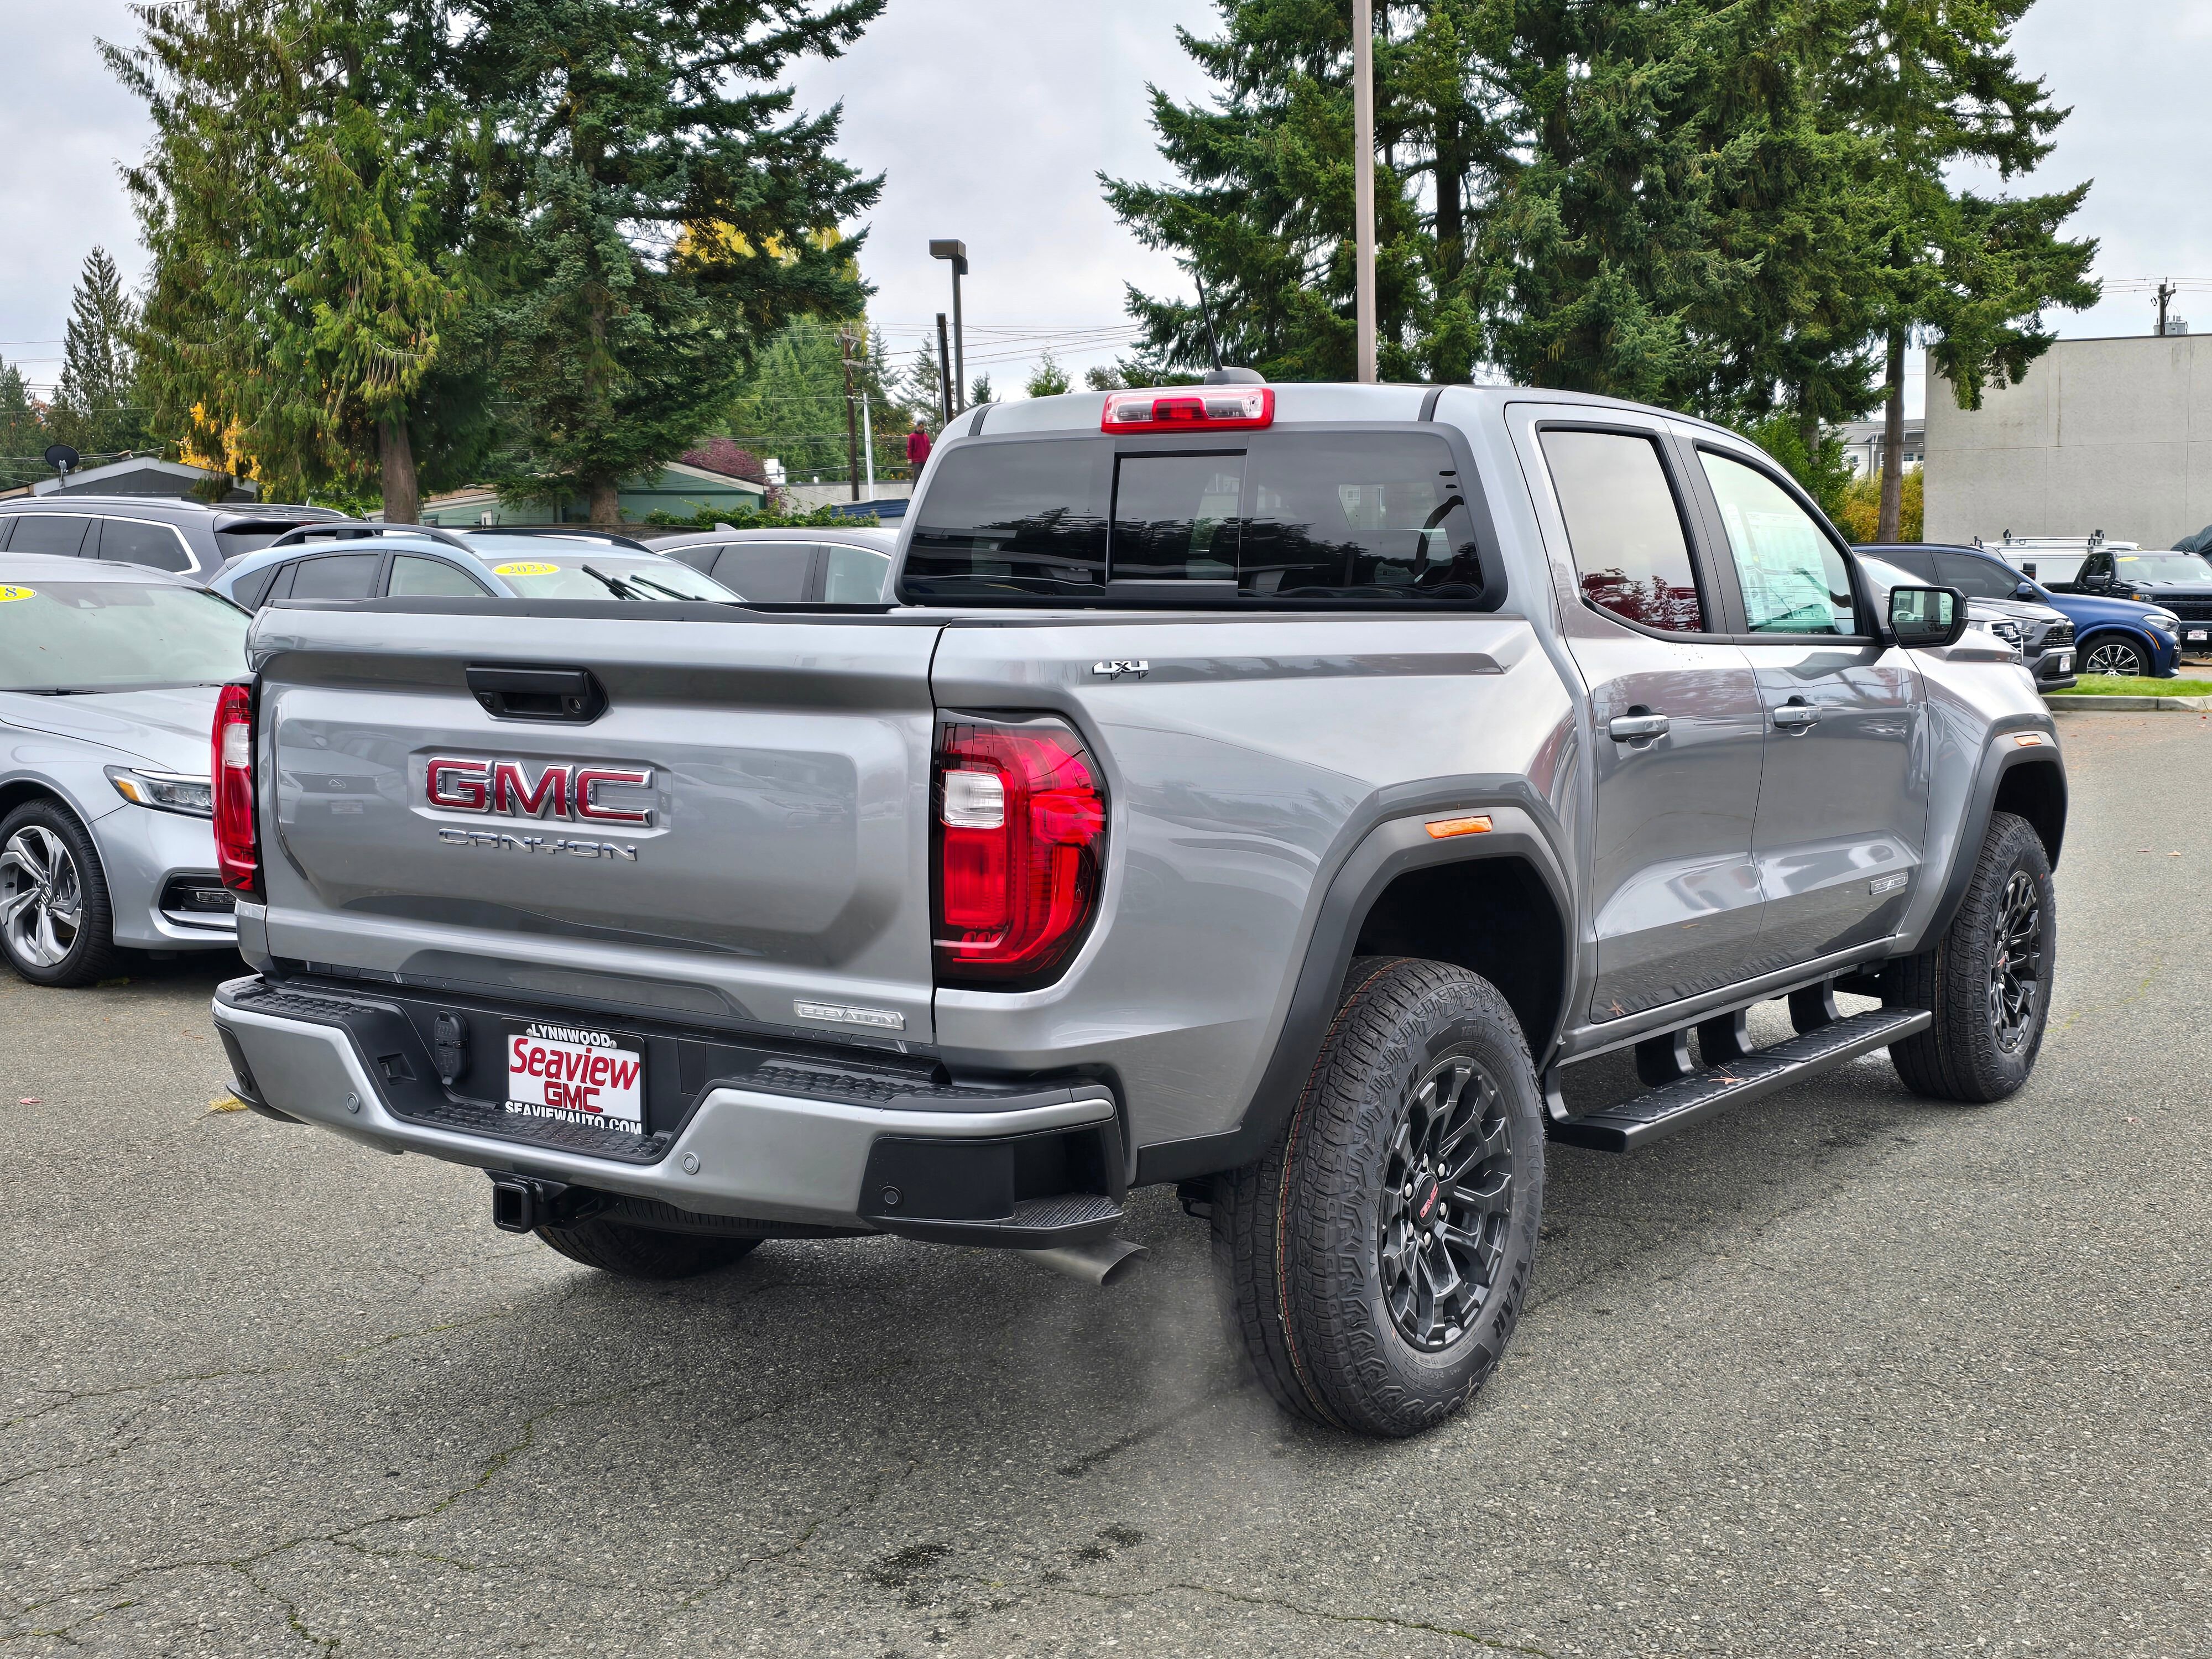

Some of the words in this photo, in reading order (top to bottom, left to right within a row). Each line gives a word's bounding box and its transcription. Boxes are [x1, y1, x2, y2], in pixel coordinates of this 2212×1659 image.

[505, 564, 549, 574] 2023
[426, 757, 655, 828] GMC
[438, 827, 638, 862] CANYON
[802, 1006, 895, 1024] ELEVATION
[531, 1024, 611, 1048] LYNNWOOD
[510, 1037, 640, 1091] Seaview
[544, 1080, 603, 1113] GMC
[504, 1100, 642, 1135] SEAVIEWAUTO.COM
